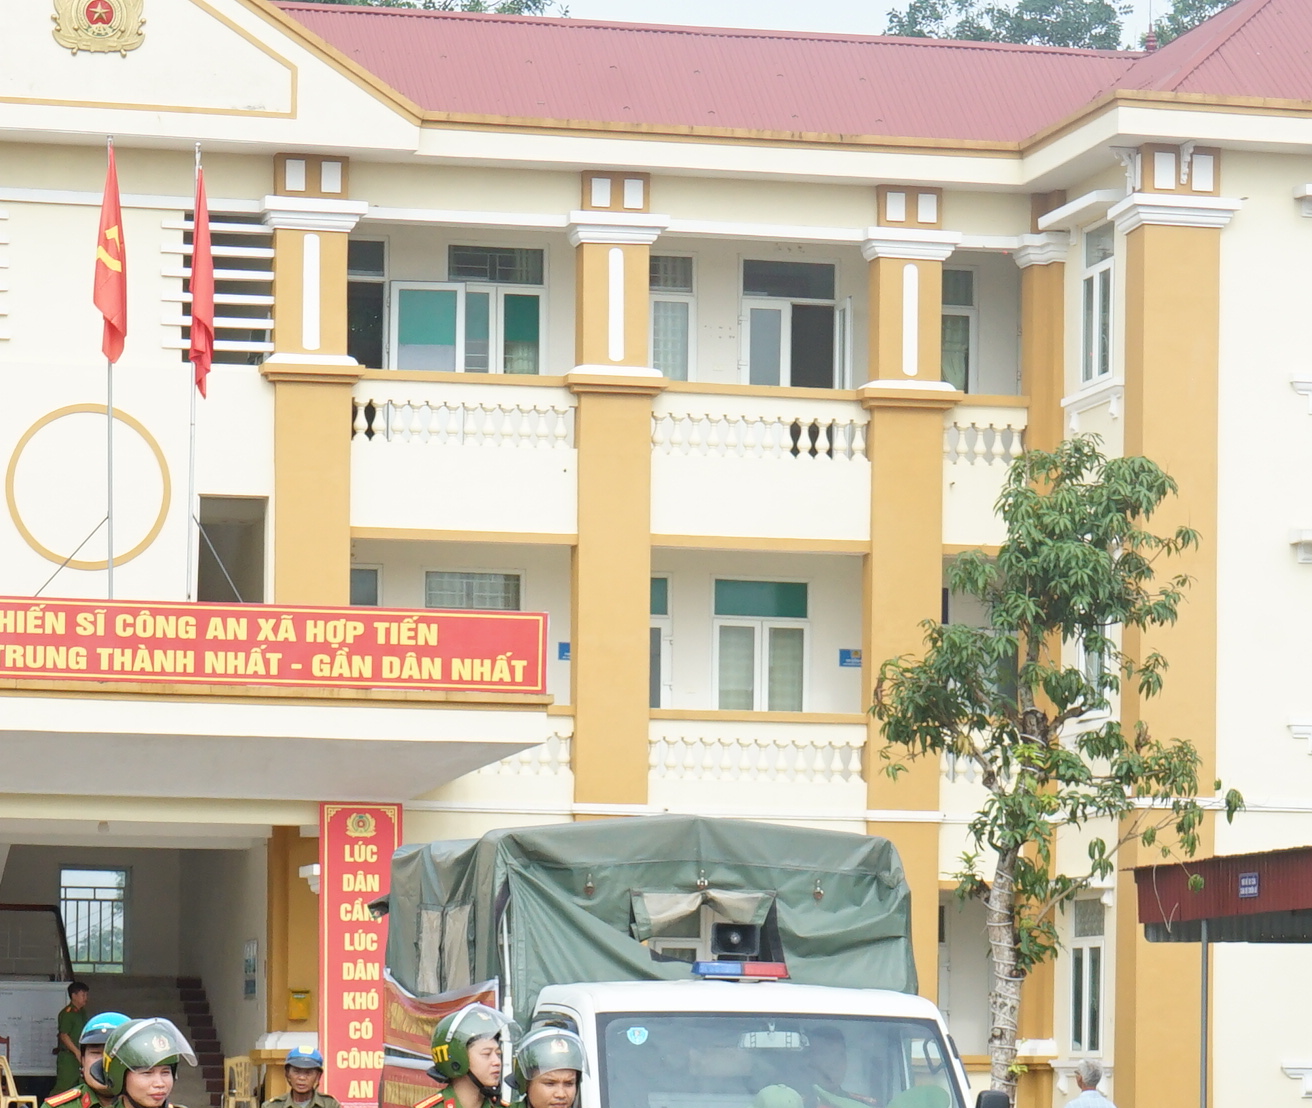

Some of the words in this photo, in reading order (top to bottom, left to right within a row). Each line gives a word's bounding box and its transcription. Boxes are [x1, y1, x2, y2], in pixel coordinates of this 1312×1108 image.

[76, 608, 107, 636] SĨ
[115, 610, 196, 639] CÔNG
[206, 617, 247, 641] AN
[257, 615, 297, 642] XÃ
[305, 618, 365, 648] HỢP
[373, 616, 438, 646] TIẾN
[96, 644, 195, 674] THÀNH
[204, 645, 282, 675] NHẤT
[312, 647, 372, 678] GẦN
[382, 652, 442, 680] DÂN
[451, 652, 527, 682] NHẤT
[344, 841, 378, 863] LÚC
[342, 870, 380, 892] DÂN
[344, 929, 378, 951] LÚC
[342, 959, 380, 981] DÂN
[342, 988, 379, 1010] KHÓ
[349, 1018, 373, 1039] CÓ
[336, 1047, 385, 1069] CÔNG
[348, 1080, 374, 1098] AN
